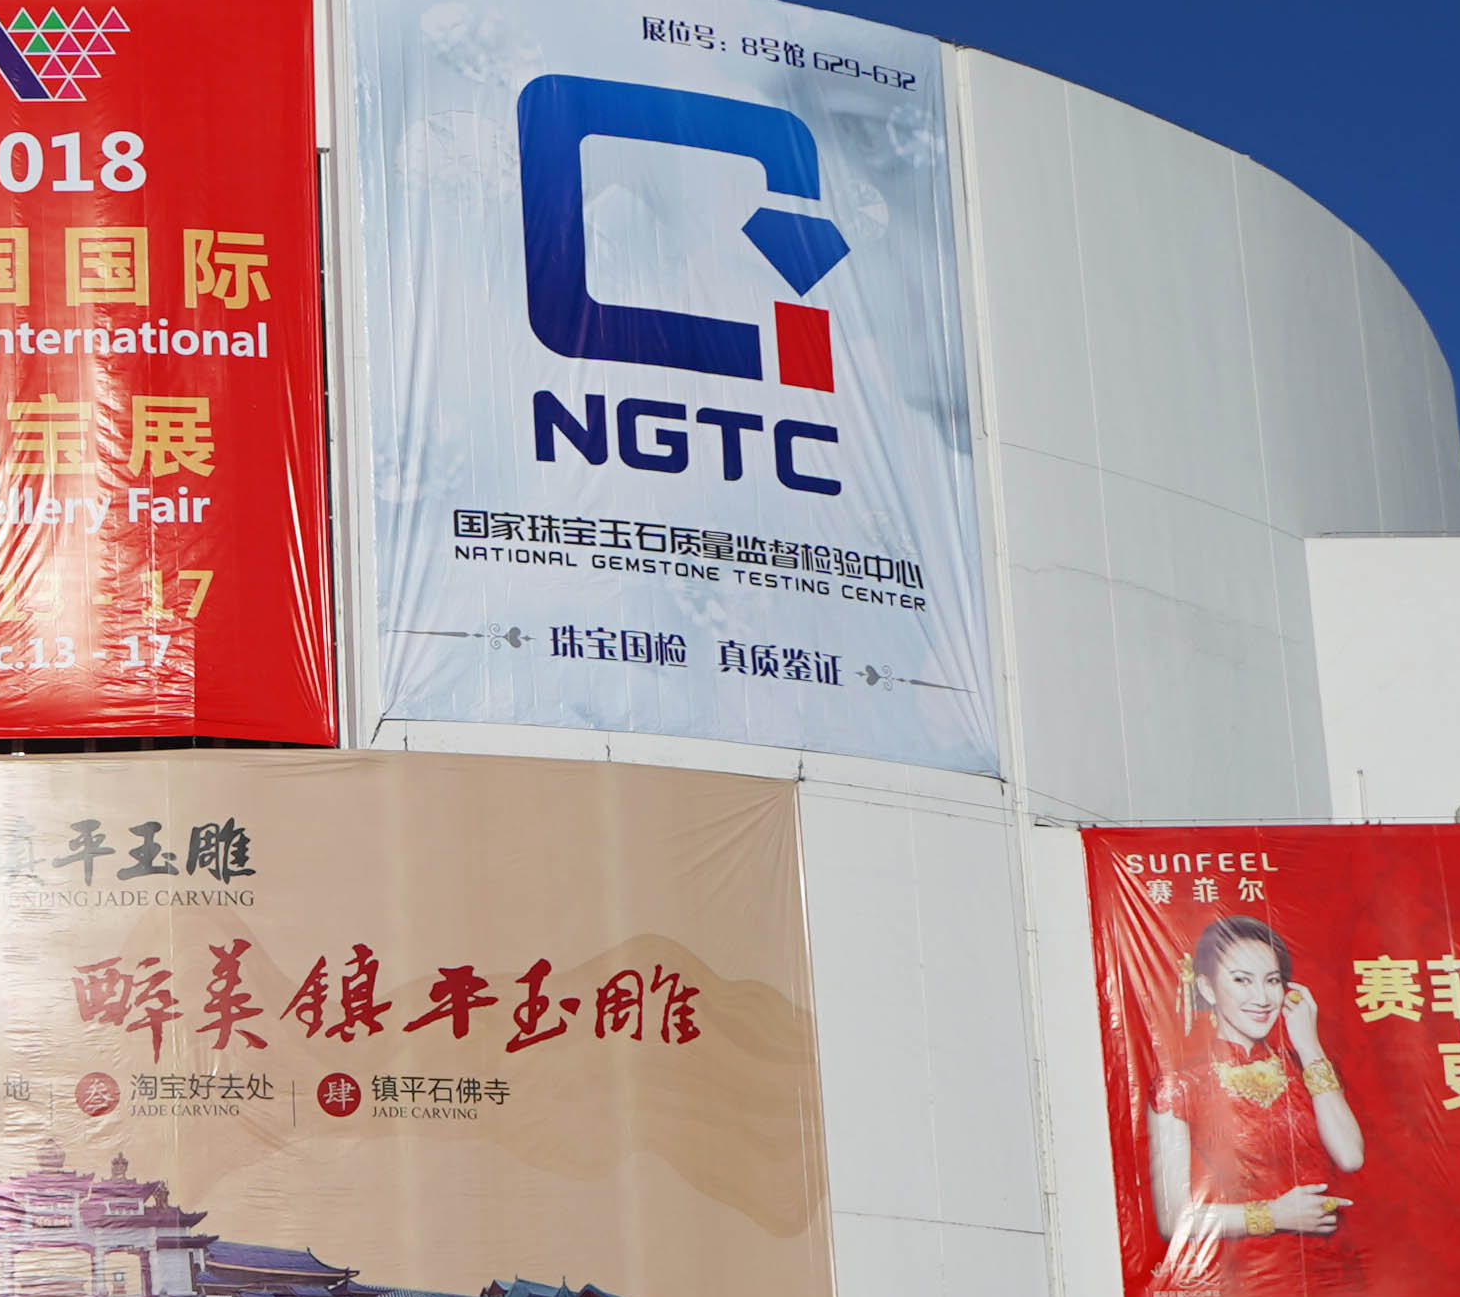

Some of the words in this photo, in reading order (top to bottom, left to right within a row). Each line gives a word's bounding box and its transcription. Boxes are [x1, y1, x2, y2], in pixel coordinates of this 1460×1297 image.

[813, 51, 917, 92] 629-632
[533, 390, 843, 497] NGTC
[128, 486, 211, 524] Fair
[453, 509, 923, 591] 国家珠宝玉石质量监督检验中心
[140, 569, 215, 622] 17
[454, 545, 577, 568] NATIONAL
[592, 552, 720, 582] GEMSTONE
[733, 569, 831, 597] TESTING
[841, 585, 927, 613] CENTER
[124, 635, 172, 668] 17
[549, 624, 688, 668] 珠宝国检
[717, 637, 845, 689] 真质鉴证
[1126, 853, 1280, 874] SUNFEEL
[94, 889, 148, 907] JADE
[155, 888, 256, 907] CARVING
[130, 1073, 275, 1102] 淘宝好去处
[371, 1074, 511, 1107] 镇平石佛寺
[130, 1104, 165, 1118] JADE
[169, 1103, 241, 1118] CARVING
[371, 1106, 406, 1120] JADE
[411, 1106, 478, 1120] CARVING
